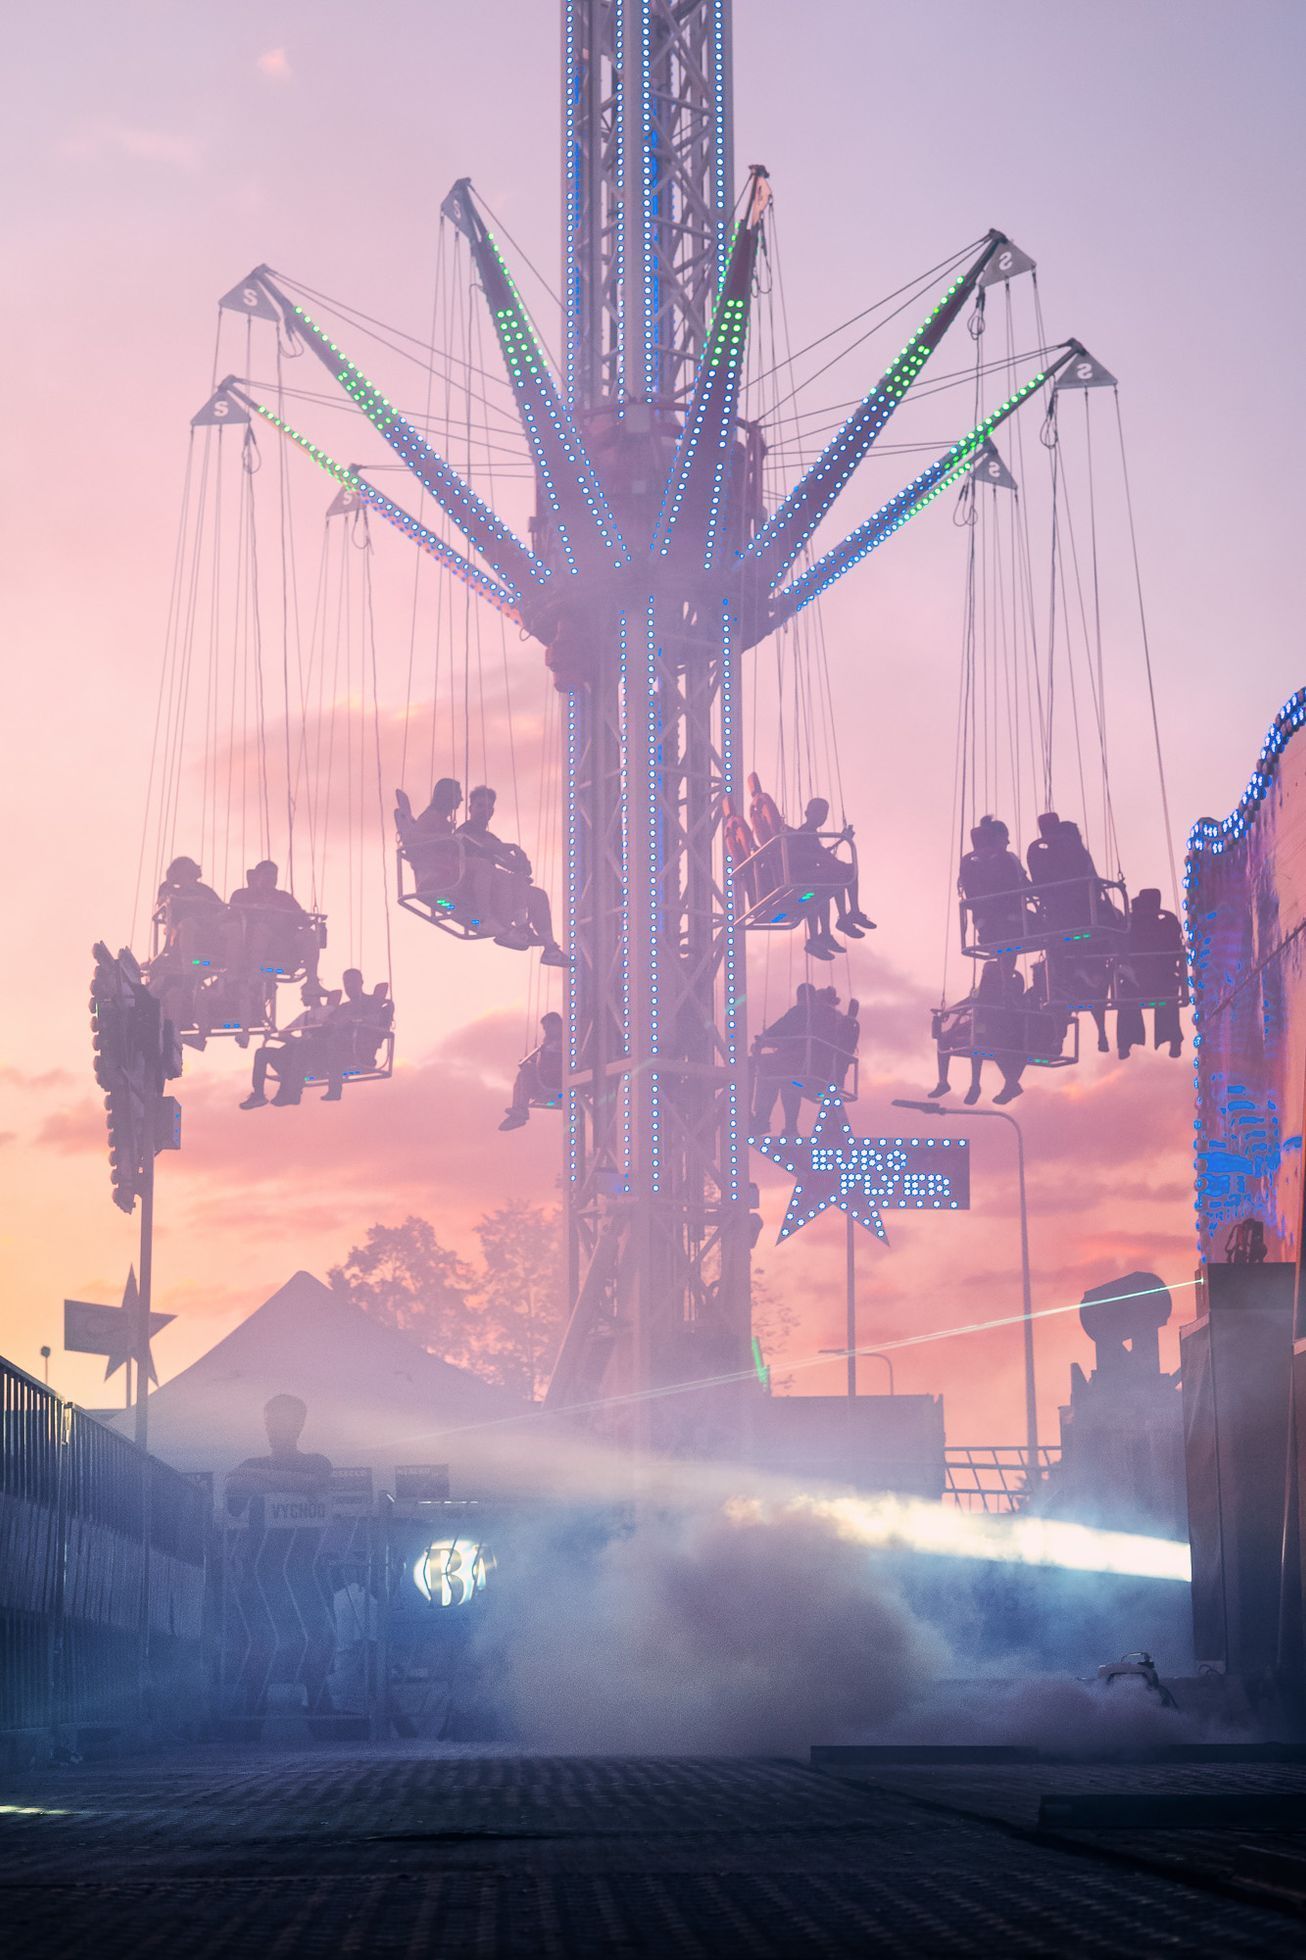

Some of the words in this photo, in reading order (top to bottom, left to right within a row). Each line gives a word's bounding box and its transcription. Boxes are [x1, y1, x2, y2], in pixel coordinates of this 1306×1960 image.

[243, 288, 259, 307] S
[213, 400, 229, 417] S
[811, 1148, 907, 1171] EURO
[840, 1173, 951, 1196] FLYER
